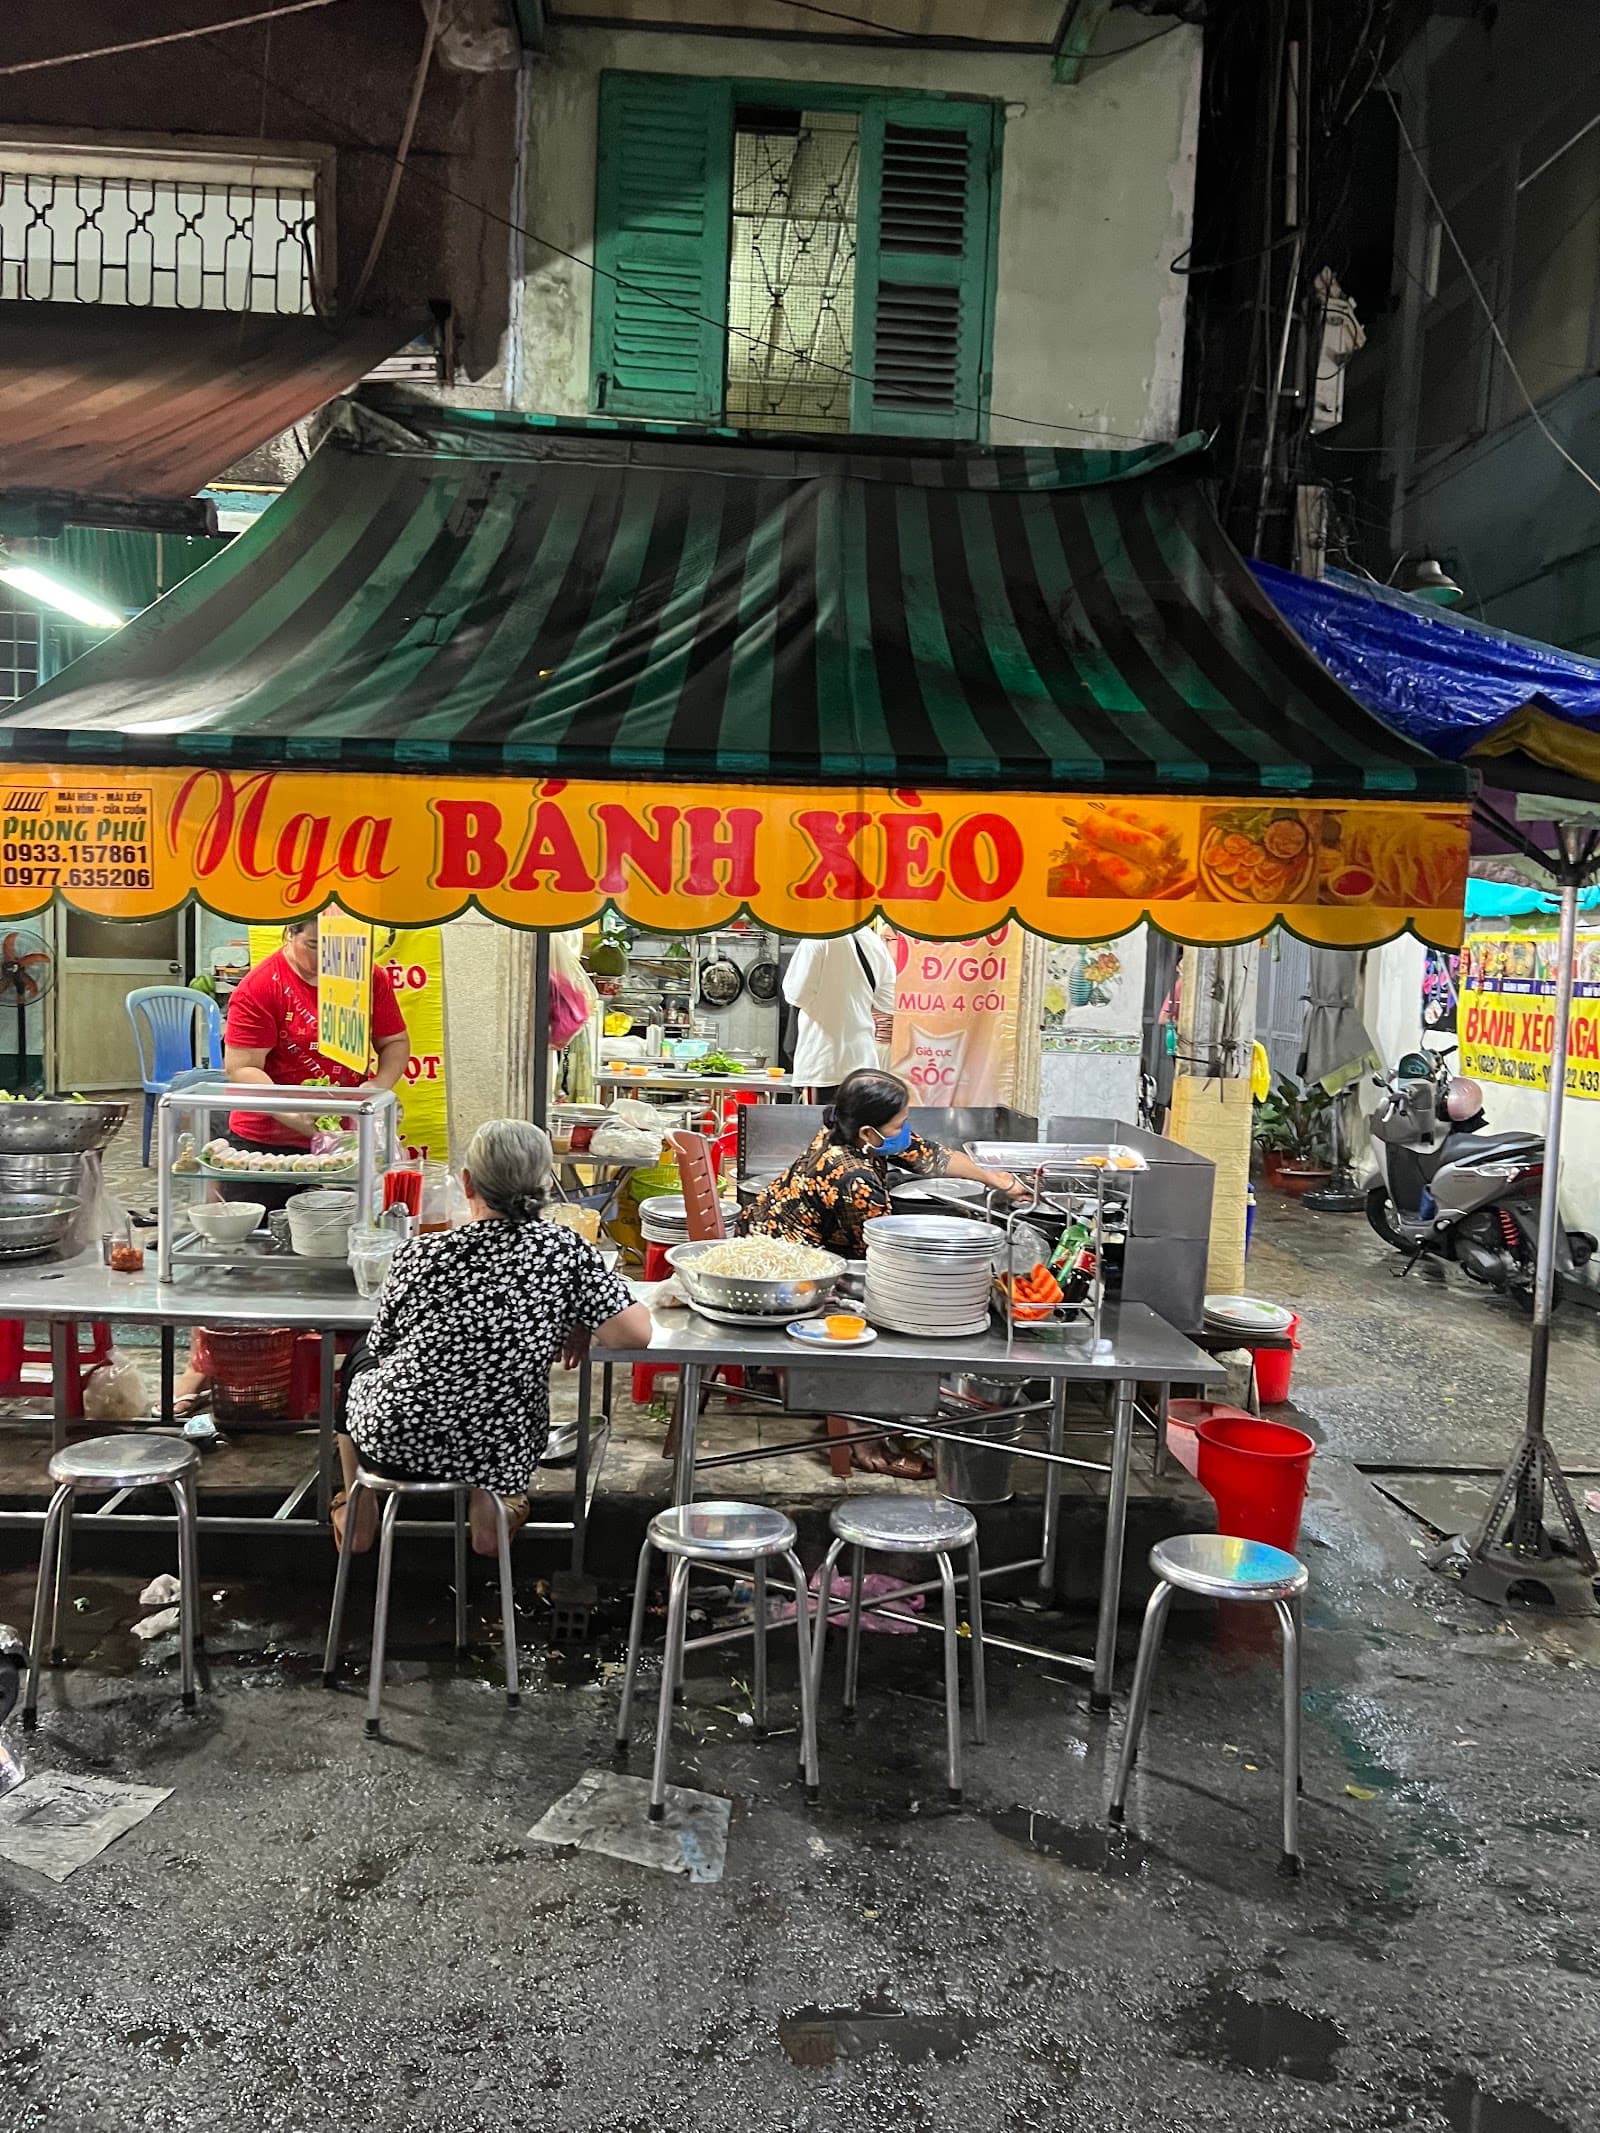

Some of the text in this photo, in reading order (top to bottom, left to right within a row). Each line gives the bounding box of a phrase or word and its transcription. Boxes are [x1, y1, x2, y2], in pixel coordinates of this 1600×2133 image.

[3, 816, 146, 842] PHONG PHÚ
[168, 767, 1023, 904] Nga BÁNH XÈO
[3, 844, 147, 863] 0933.157861
[4, 866, 149, 887] 0977.635206
[386, 959, 427, 989] ÈO
[922, 952, 1007, 982] Đ/GÓI
[898, 989, 1006, 1012] MUA 4 GÓI
[1466, 1001, 1516, 1049] BÁNH
[1520, 1006, 1556, 1054] XÈO
[915, 1046, 934, 1057] Giá
[910, 1057, 956, 1086] SỐC
